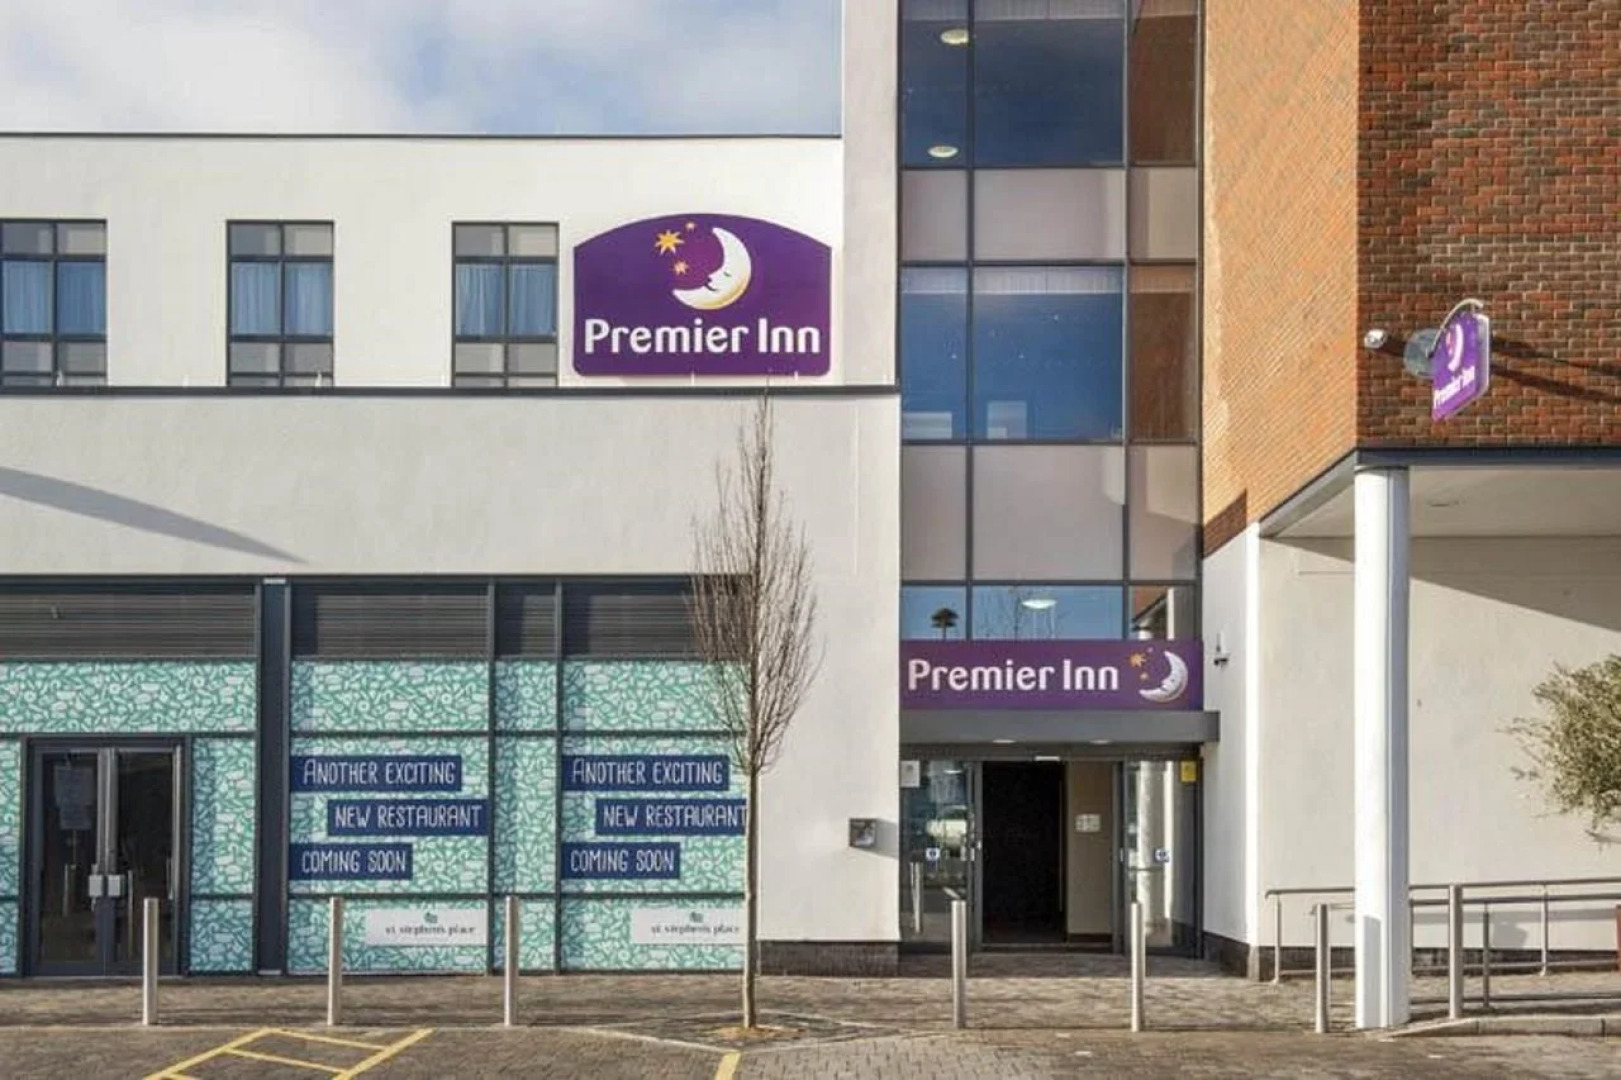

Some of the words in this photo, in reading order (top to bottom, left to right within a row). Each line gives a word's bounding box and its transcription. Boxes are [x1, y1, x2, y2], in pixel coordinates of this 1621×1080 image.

[584, 317, 749, 354] Premier
[758, 317, 820, 354] Inn
[907, 658, 1055, 691] Premier
[1062, 659, 1119, 691] Inn
[303, 758, 378, 785] ANOTHER
[385, 761, 456, 785] EXCITING
[571, 758, 646, 785] ANOTHER
[652, 760, 723, 785] EXCITING
[334, 804, 371, 828] NEW
[377, 804, 482, 828] RESTAURANT
[603, 804, 638, 828] NEW
[645, 804, 747, 828] RESTAURANT
[302, 850, 360, 873] COMING
[367, 850, 406, 873] SOON
[570, 849, 628, 872] COMING
[636, 849, 674, 872] SOON
